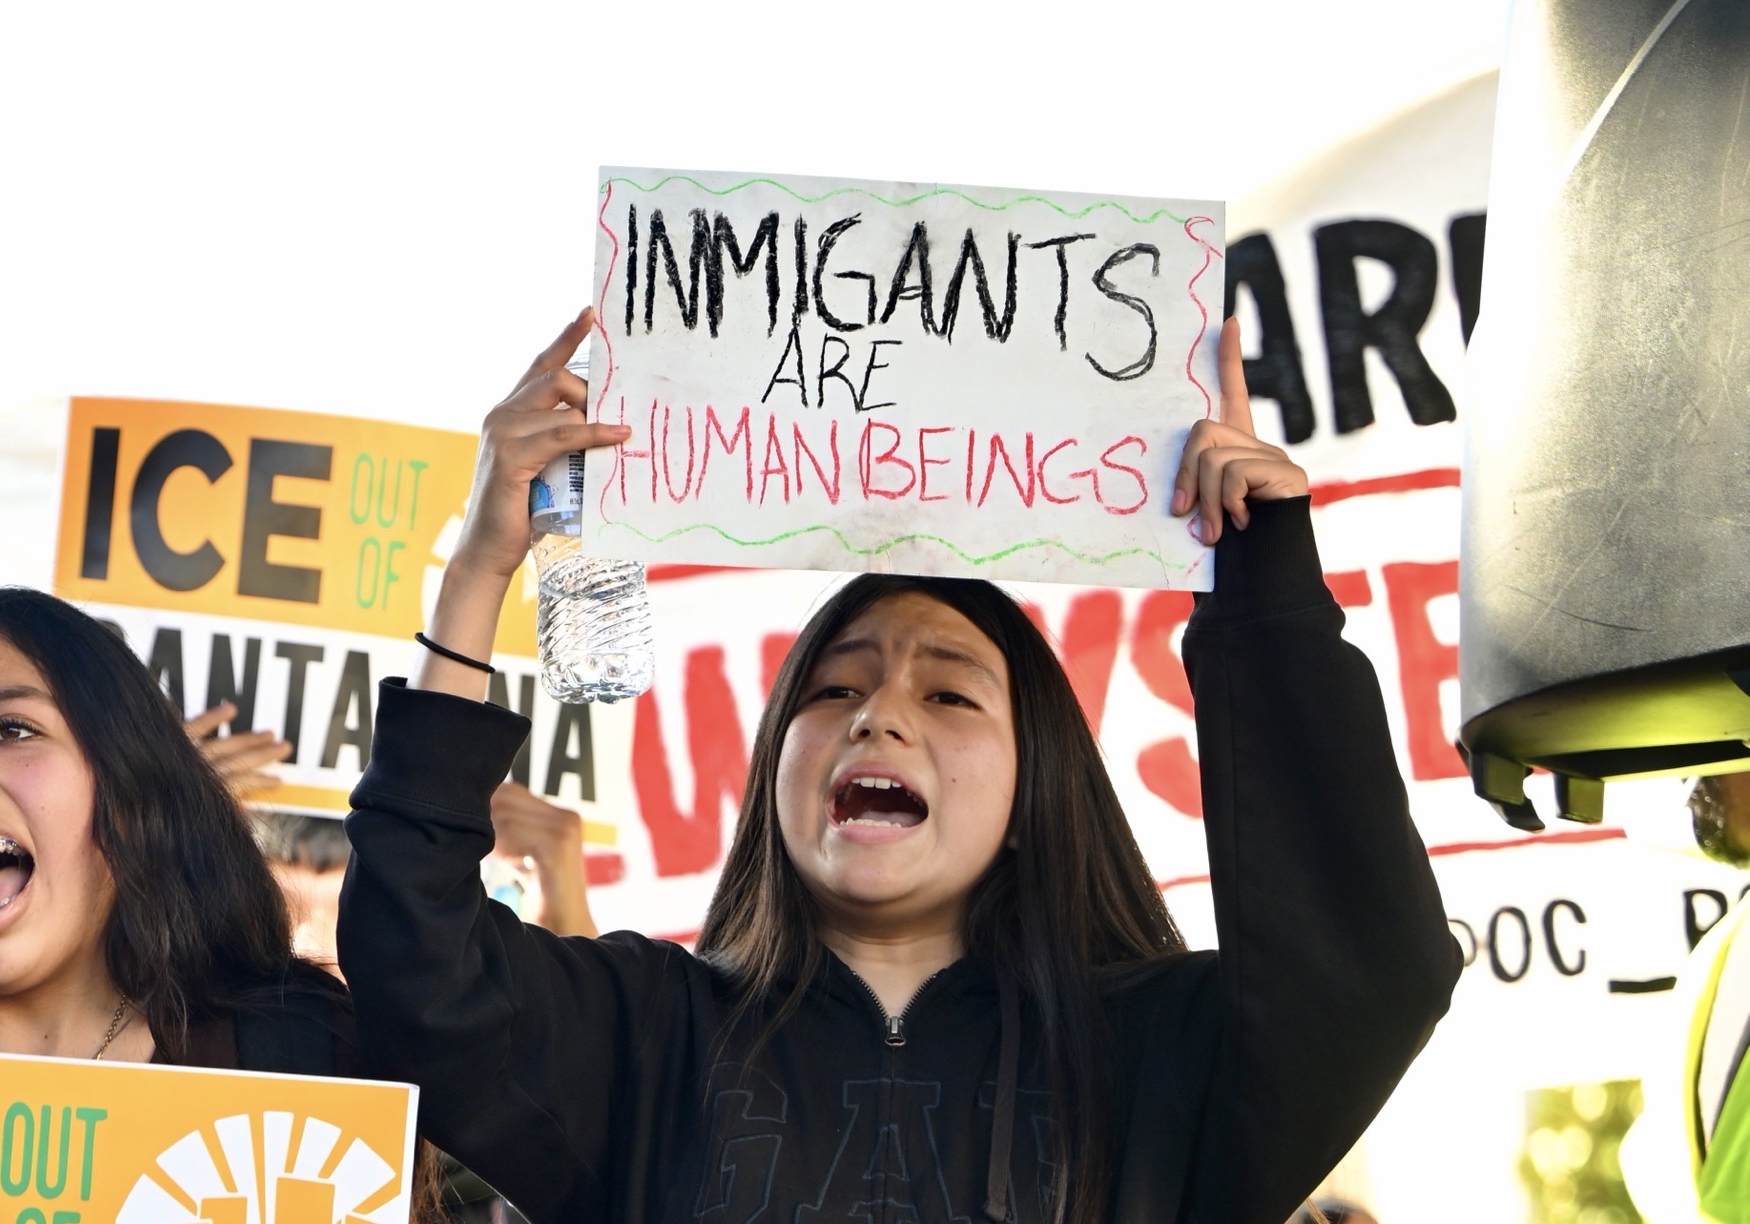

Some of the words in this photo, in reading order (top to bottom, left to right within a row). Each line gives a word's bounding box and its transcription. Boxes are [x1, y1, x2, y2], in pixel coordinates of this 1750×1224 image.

[625, 203, 1161, 381] INMIGANTS
[761, 328, 902, 413] ARE
[350, 453, 429, 530] OUT
[619, 396, 841, 508] HUMAN
[859, 418, 1148, 515] BEINGS
[80, 427, 333, 604] ICE
[355, 536, 406, 613] OF
[0, 1101, 108, 1202] OUT
